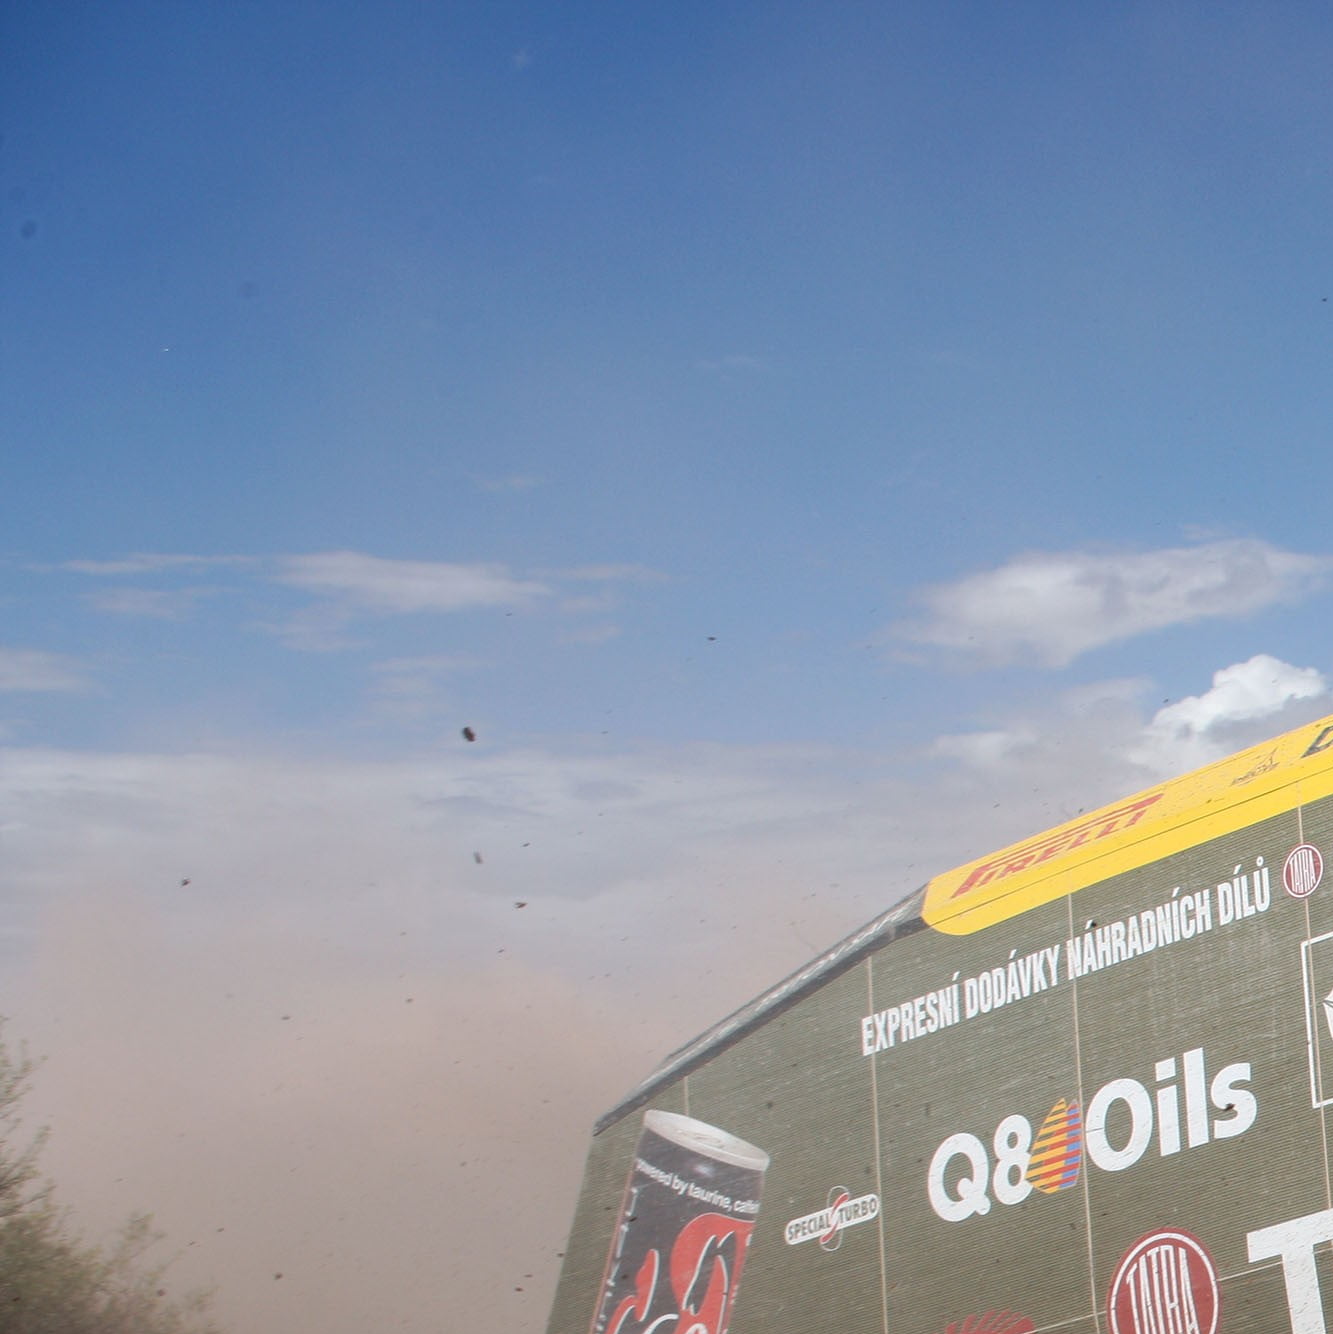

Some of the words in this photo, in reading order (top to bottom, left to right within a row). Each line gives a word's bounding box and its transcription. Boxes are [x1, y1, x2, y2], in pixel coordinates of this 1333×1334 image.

[952, 794, 1165, 898] PIRELLI
[862, 971, 960, 1056] EXPRESNÍ
[965, 944, 1060, 1019] DODÁVKY
[1068, 887, 1212, 980] NÁHRADNÍCH
[1219, 856, 1270, 927] DÍLŮ
[927, 1115, 1033, 1222] Q8
[1086, 1047, 1258, 1171] Oils
[787, 1215, 831, 1241] SPECIAL
[839, 1198, 878, 1221] TURBO
